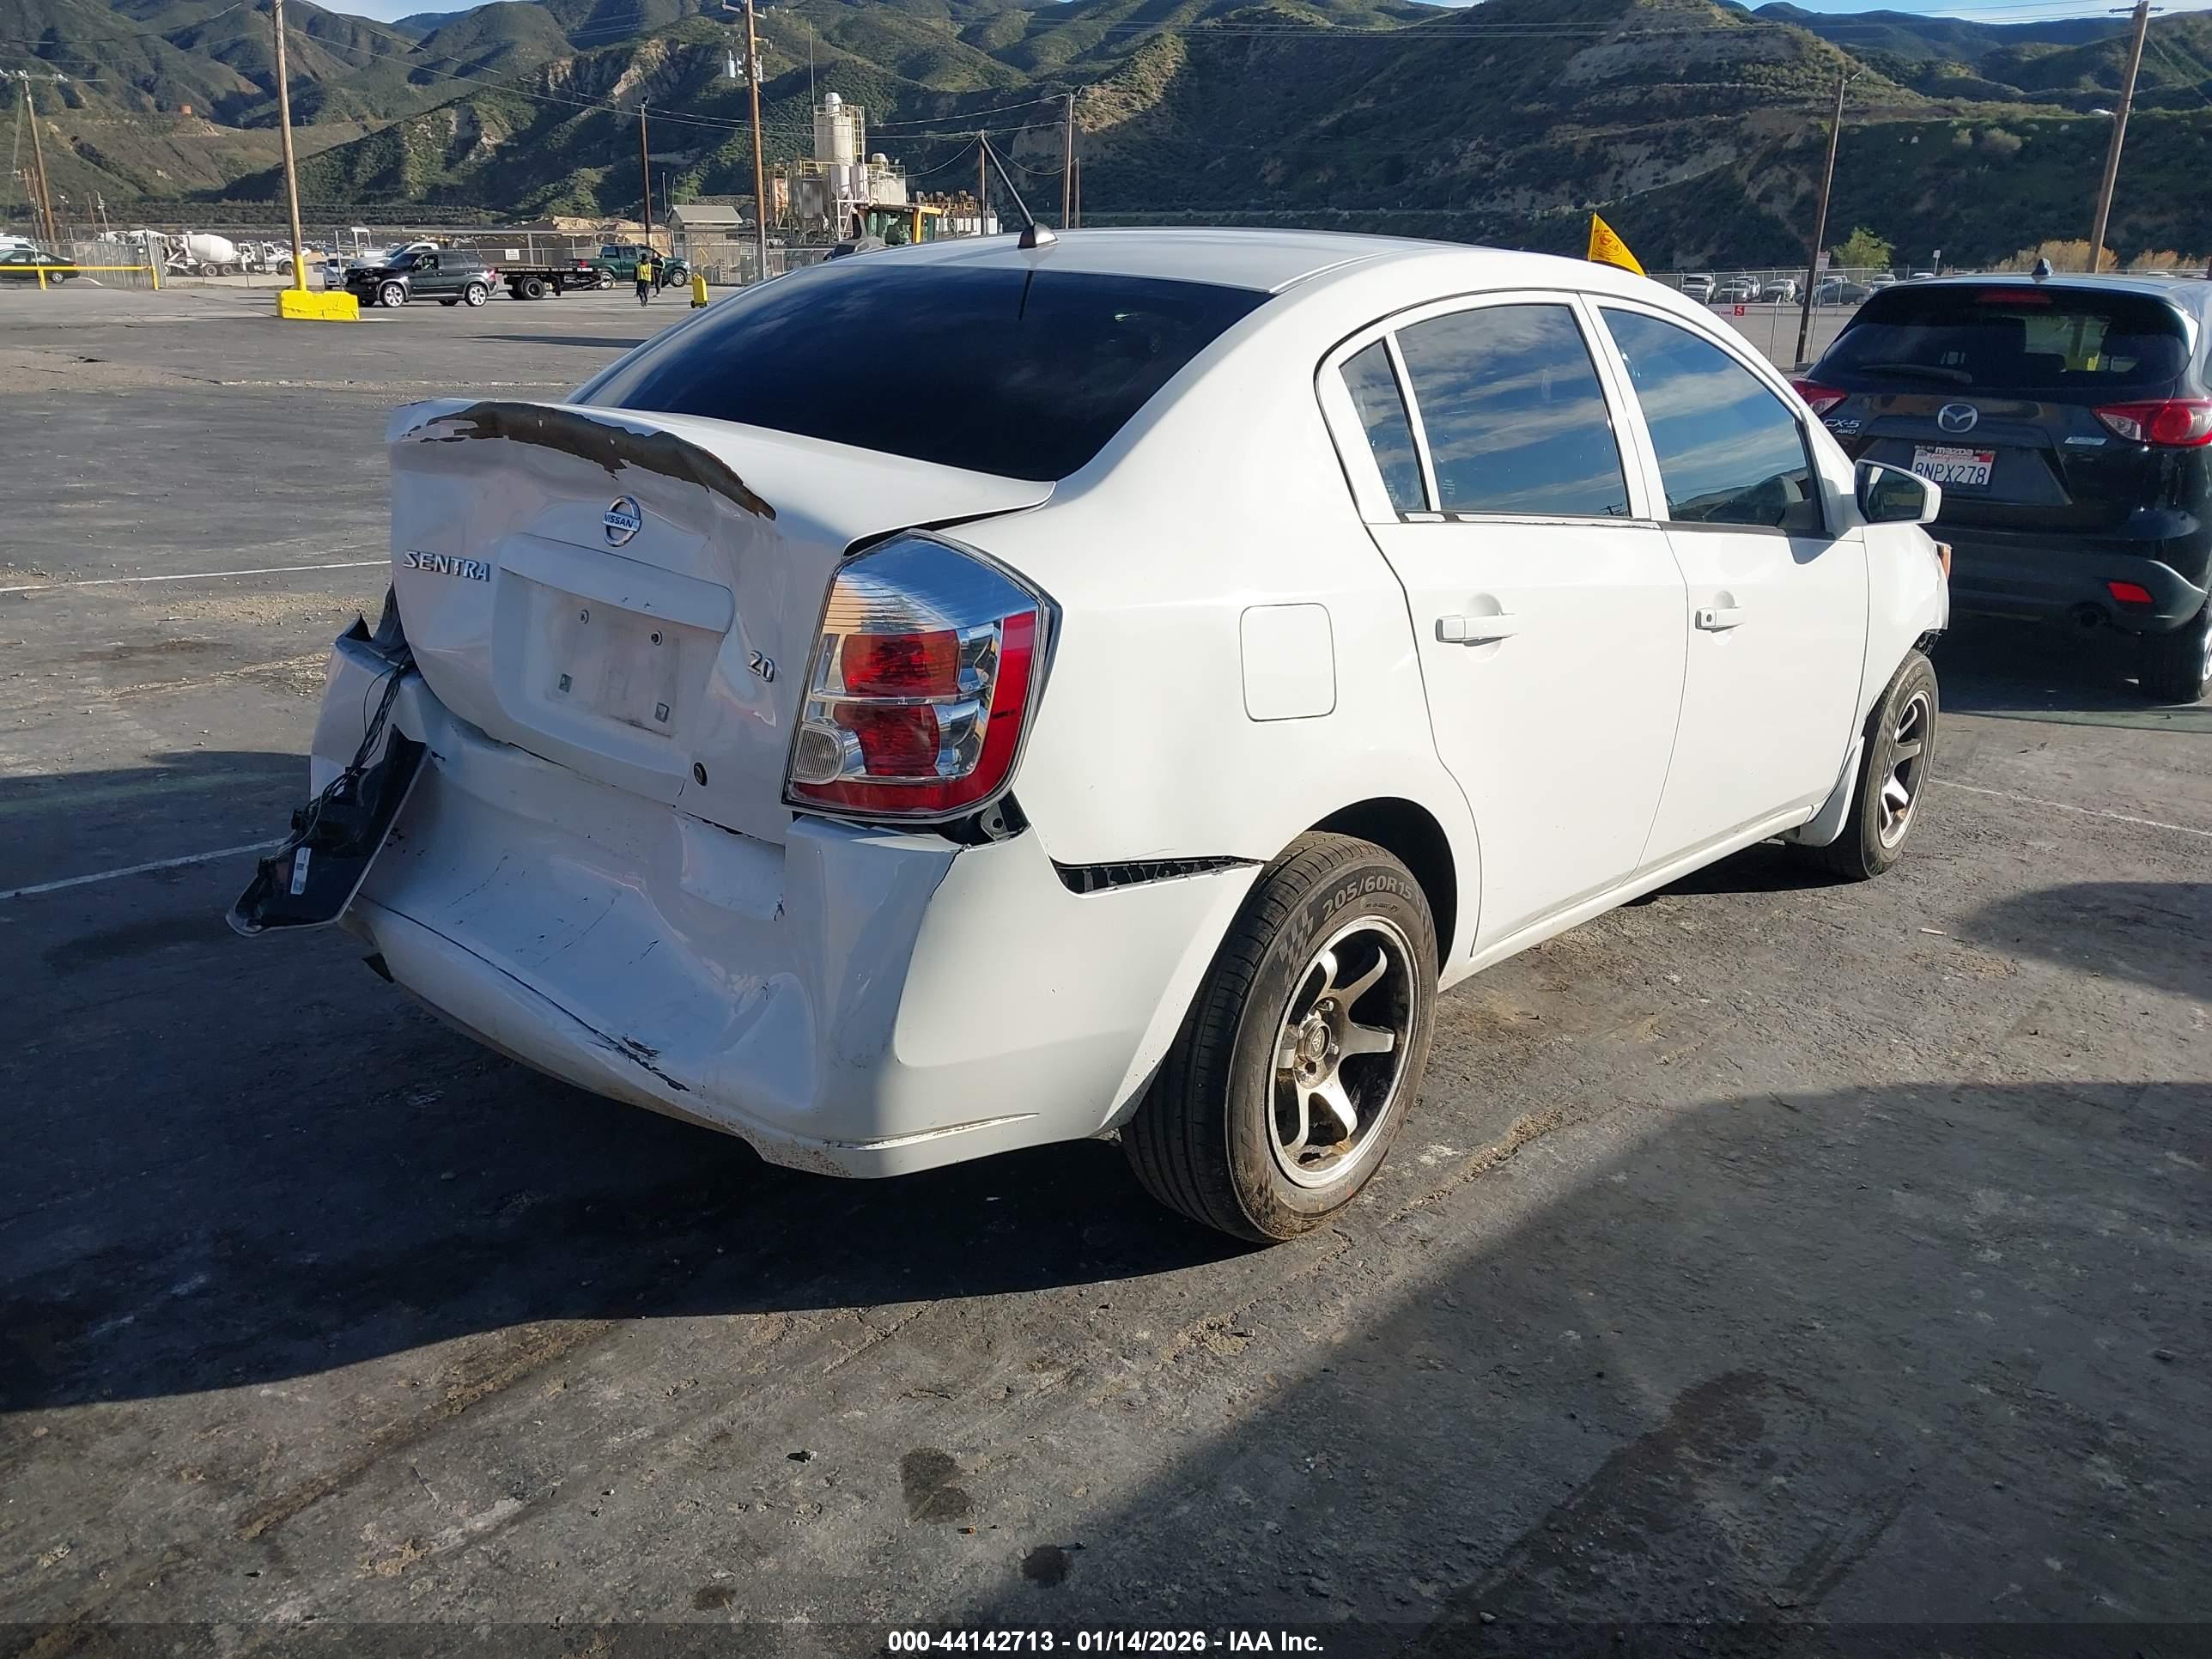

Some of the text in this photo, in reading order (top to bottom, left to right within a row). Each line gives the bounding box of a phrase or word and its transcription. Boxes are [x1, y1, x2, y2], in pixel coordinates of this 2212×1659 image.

[1824, 419, 1862, 428] CX-5
[1914, 462, 1987, 485] 8NPX278
[604, 514, 634, 529] NISSAN
[403, 550, 490, 582] SENTRA
[1322, 875, 1413, 921] 205/60R15
